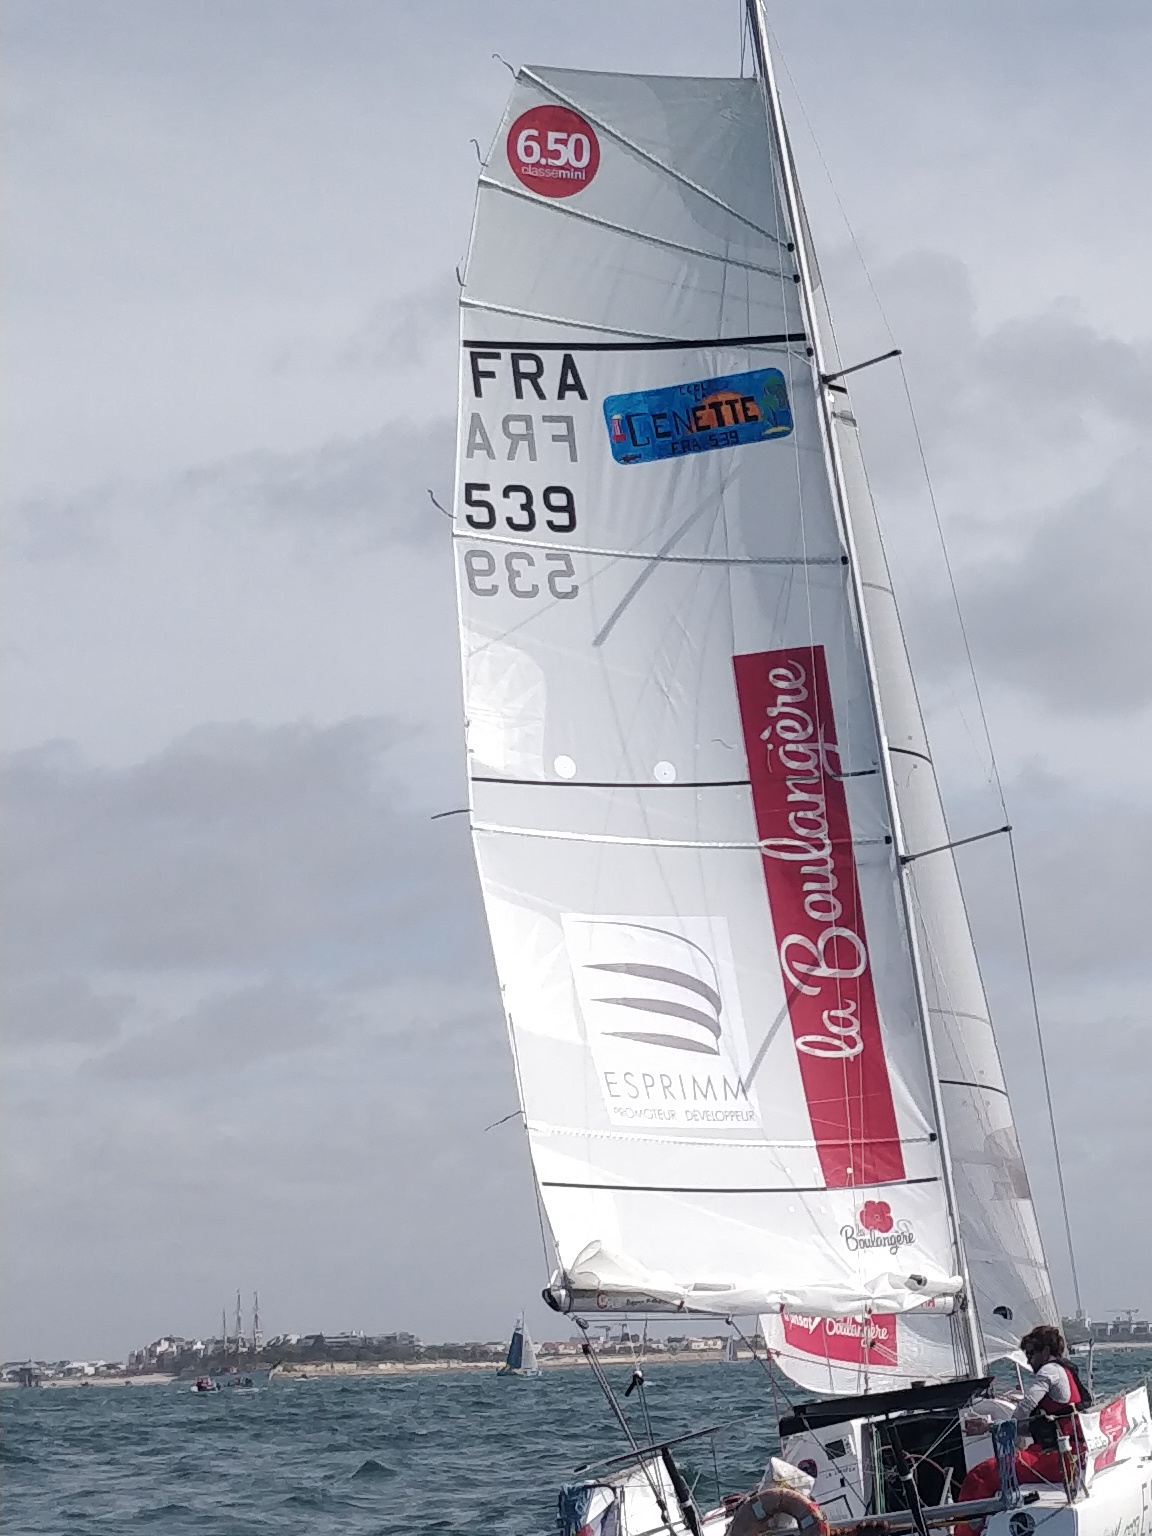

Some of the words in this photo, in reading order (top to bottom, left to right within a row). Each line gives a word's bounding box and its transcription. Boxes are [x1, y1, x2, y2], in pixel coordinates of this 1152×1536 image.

[517, 129, 590, 168] 6.50
[470, 351, 588, 400] FRA
[671, 439, 702, 455] FRA
[708, 430, 740, 447] 539
[465, 483, 577, 533] 539
[758, 658, 867, 997] Boulangère
[604, 1072, 749, 1101] ESPRIMM
